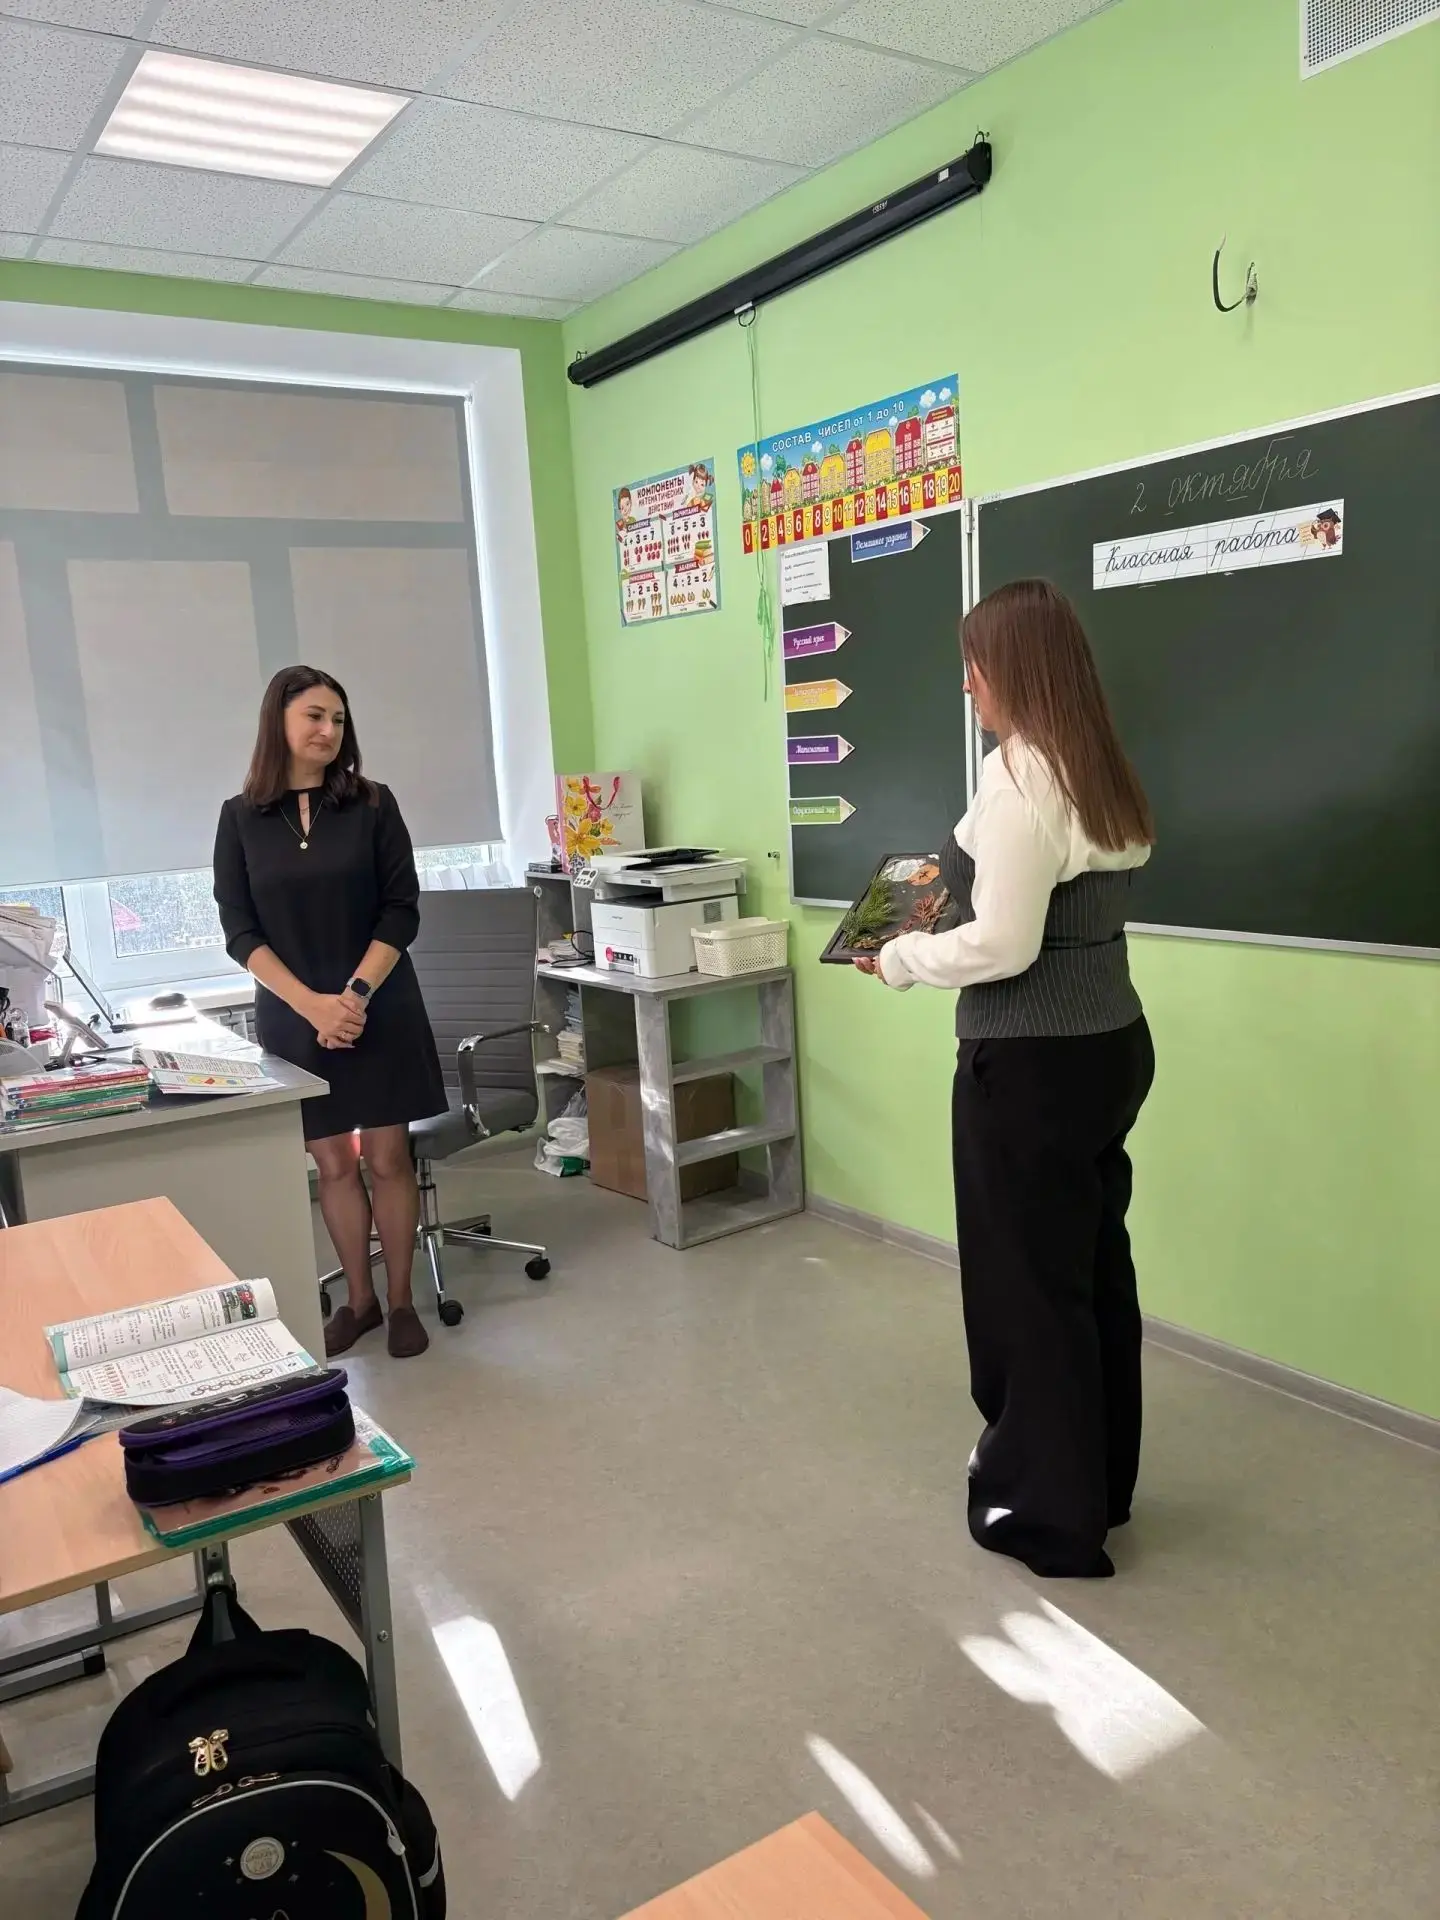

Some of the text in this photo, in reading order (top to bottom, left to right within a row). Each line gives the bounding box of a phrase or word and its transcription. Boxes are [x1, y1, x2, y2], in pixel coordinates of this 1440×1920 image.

[772, 400, 904, 453] СОСТАВ ЧИСЕЛ от 1 до 10
[1130, 436, 1319, 515] 2 октября
[637, 476, 685, 499] КОМПОНЕНТЫ
[638, 486, 684, 508] МАТЕМАТИЧЕСКИХ
[745, 529, 750, 546] 0
[762, 524, 768, 542] 2
[770, 520, 776, 541] 3
[778, 520, 784, 537] 4
[786, 516, 792, 536] 5
[795, 514, 802, 533] 6
[805, 511, 812, 532] 7
[814, 510, 821, 528] 8
[823, 506, 831, 526] 9
[833, 504, 843, 523] 10
[844, 500, 853, 522] 11
[855, 498, 865, 518] 12
[866, 495, 875, 515] 13
[877, 491, 887, 513] 14
[888, 488, 898, 509] 15
[899, 485, 909, 506] 16
[911, 481, 921, 504] 17
[924, 479, 935, 500] 18
[936, 475, 947, 497] 19
[949, 472, 960, 494] 20
[684, 521, 689, 532] 5
[700, 516, 706, 528] 3
[636, 534, 641, 545] 3
[650, 530, 655, 541] 7
[855, 537, 884, 551] Домашнее
[1104, 520, 1300, 573] Классная работа
[638, 585, 644, 596] 2
[653, 582, 659, 593] 6
[673, 578, 678, 589] 4
[687, 575, 692, 586] 2
[702, 572, 708, 583] 2
[793, 635, 825, 650] Русский язык
[795, 745, 830, 754] Математика
